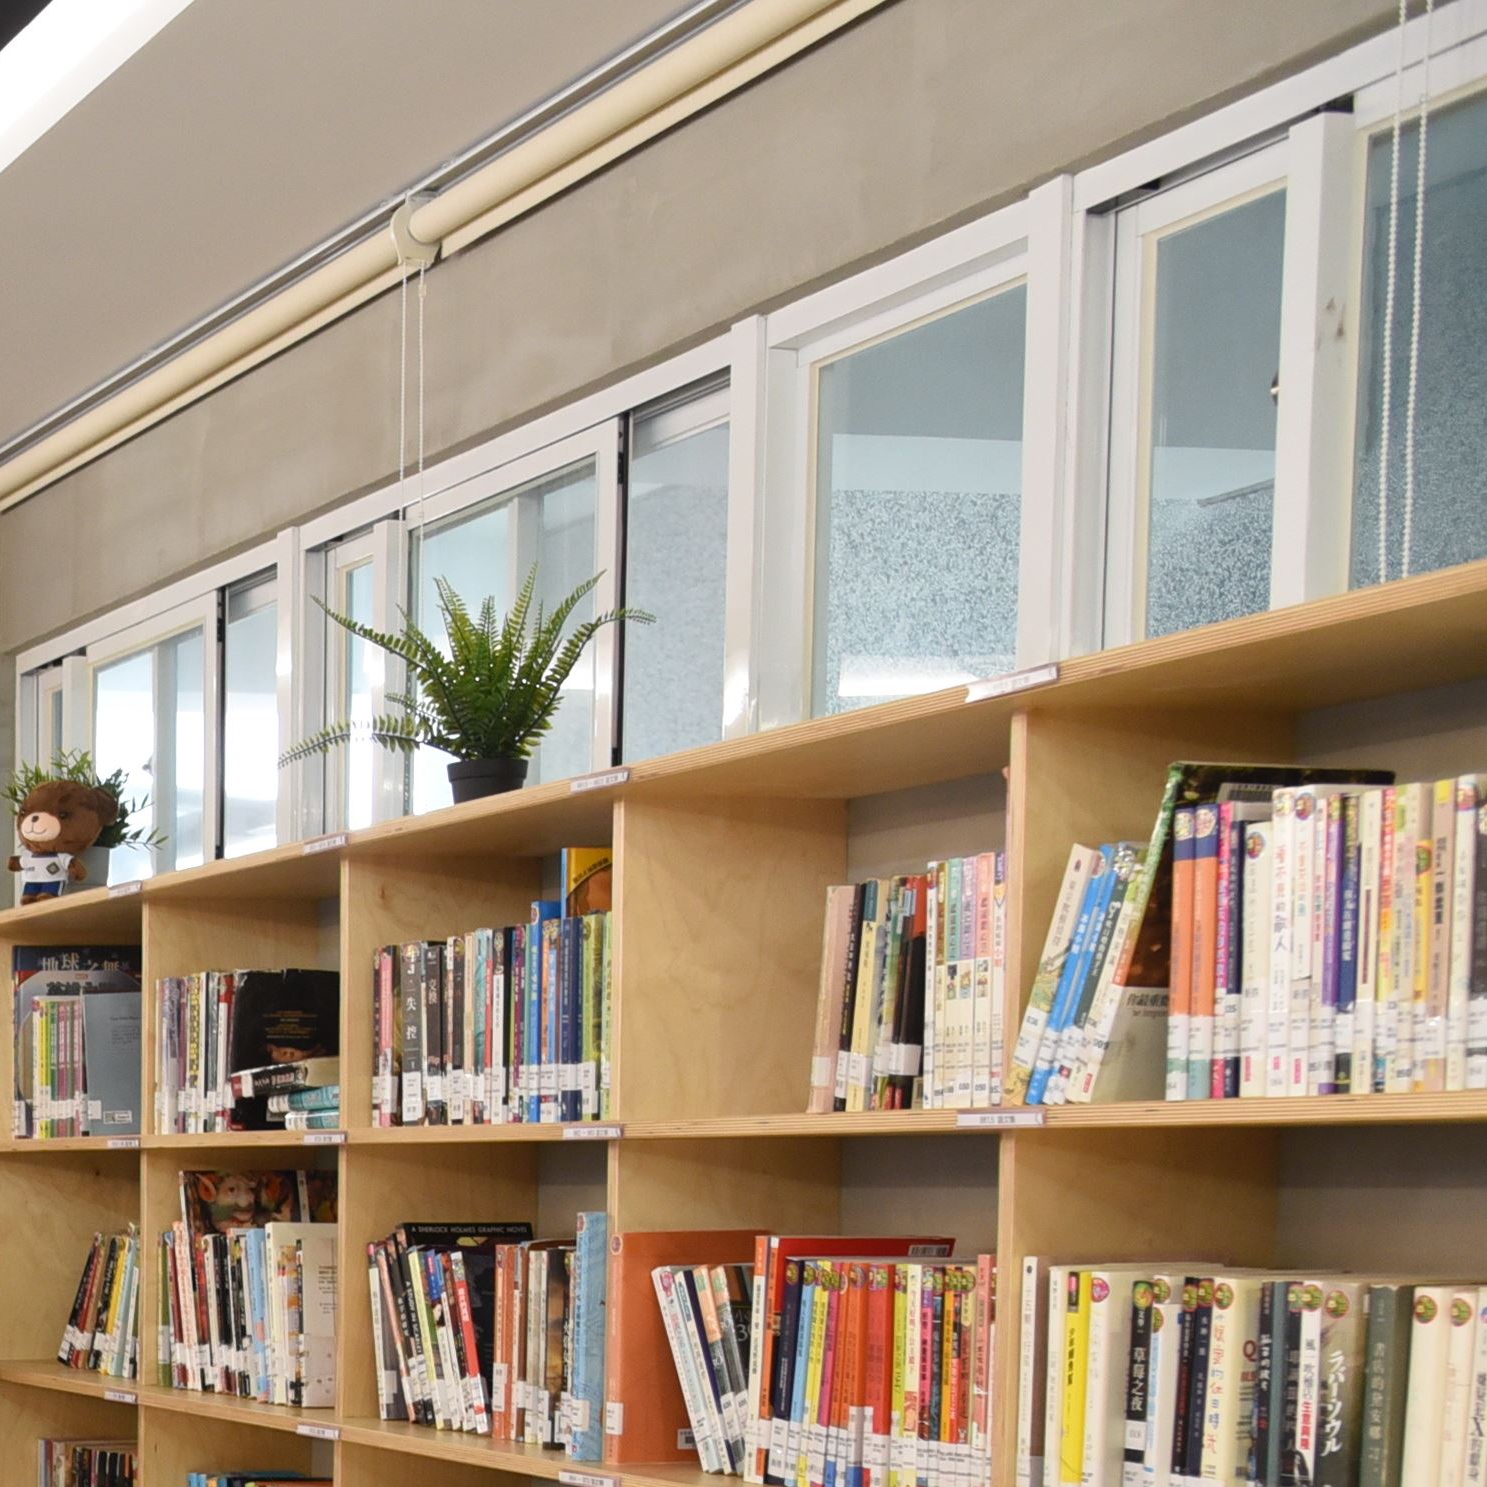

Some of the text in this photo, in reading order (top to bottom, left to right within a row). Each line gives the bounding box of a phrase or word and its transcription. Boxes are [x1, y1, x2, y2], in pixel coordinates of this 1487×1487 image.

[1319, 1349, 1347, 1458] ラバーソウル
